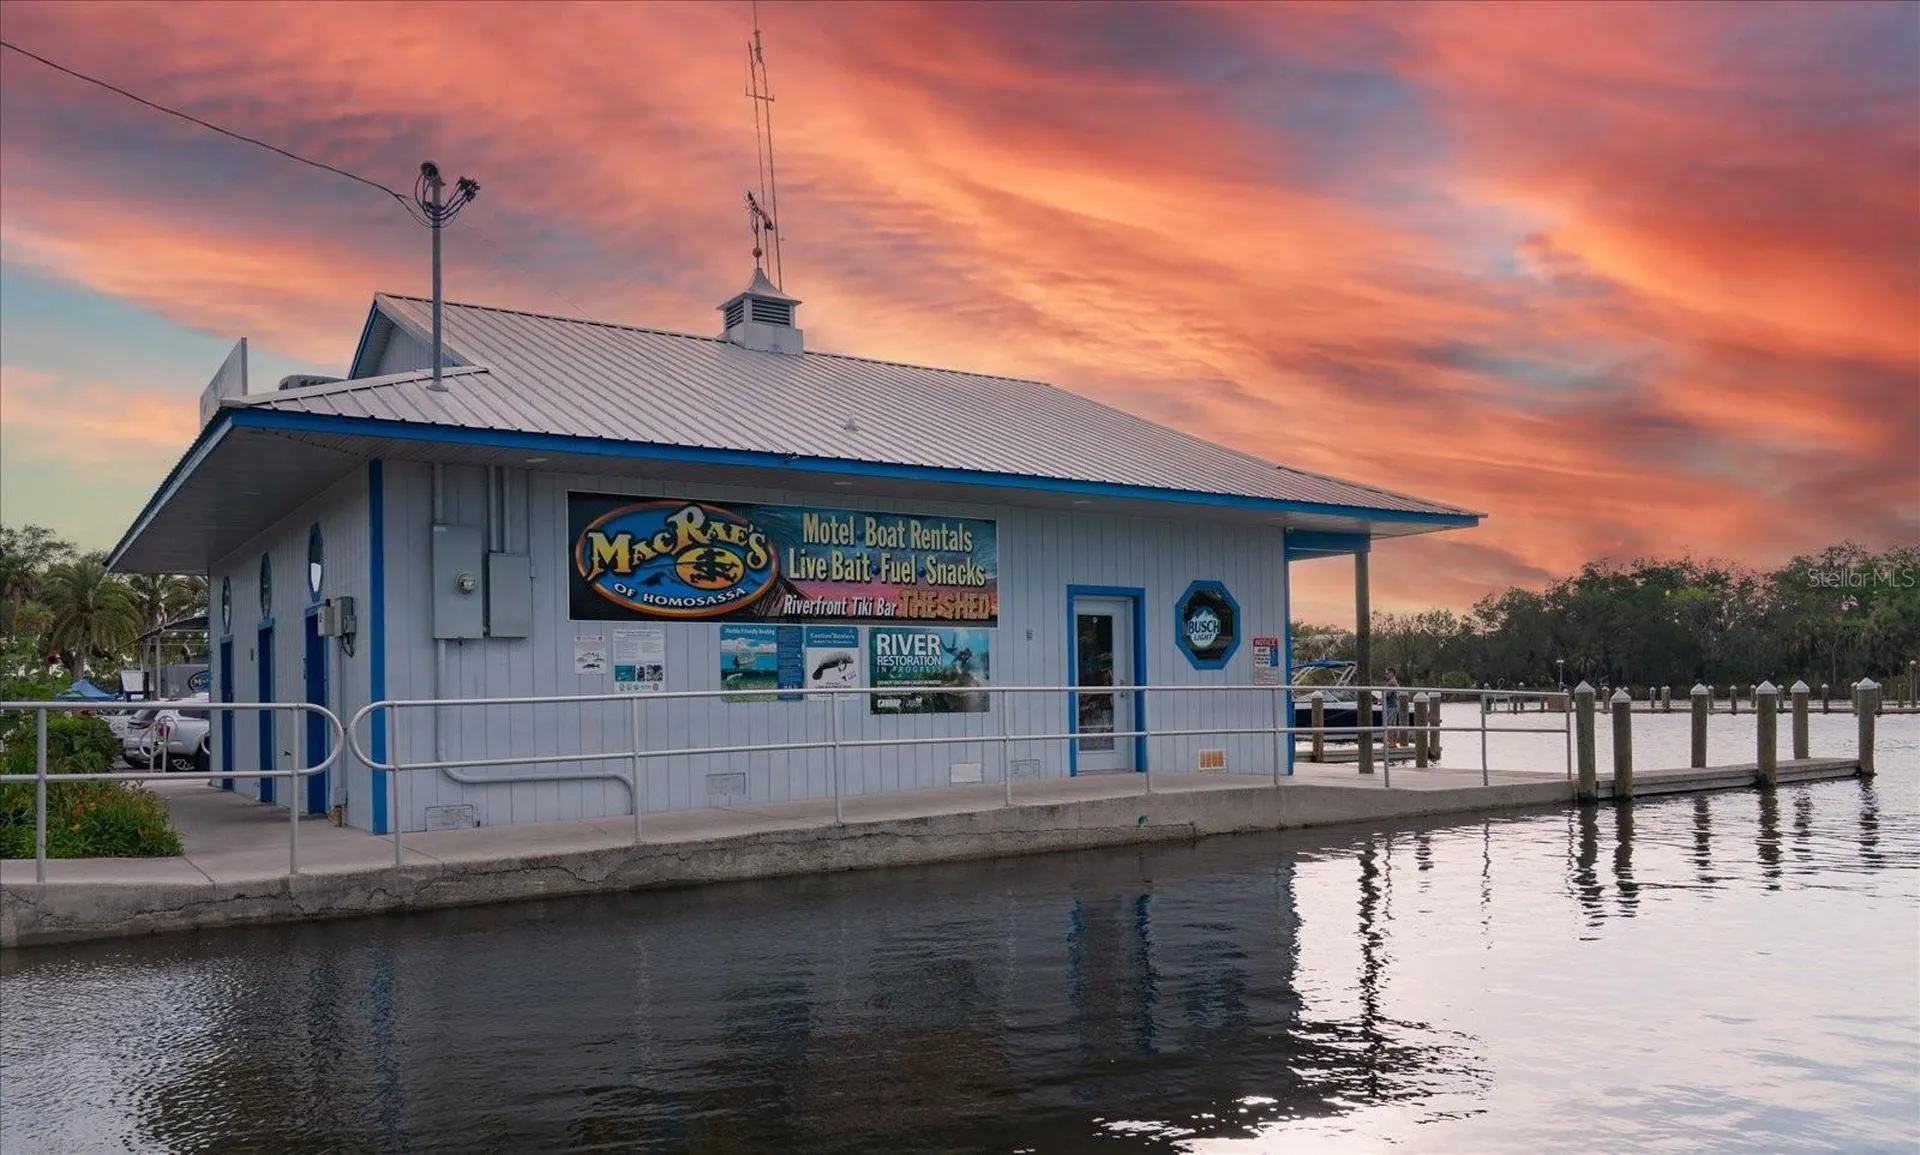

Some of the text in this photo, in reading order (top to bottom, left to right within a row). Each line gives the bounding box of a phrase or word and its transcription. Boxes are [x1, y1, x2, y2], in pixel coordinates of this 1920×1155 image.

[803, 513, 973, 552] Motel Boat Rentals
[788, 548, 986, 586] Live Bait Fuel Snacks
[614, 583, 747, 607] OF HOMOSASSA
[783, 594, 898, 616] Riverfront Tiki Bar
[1188, 619, 1220, 634] BUSCH
[1193, 633, 1213, 641] LIGHT
[876, 633, 941, 655] RIVER
[876, 655, 942, 666] RESTORATION
